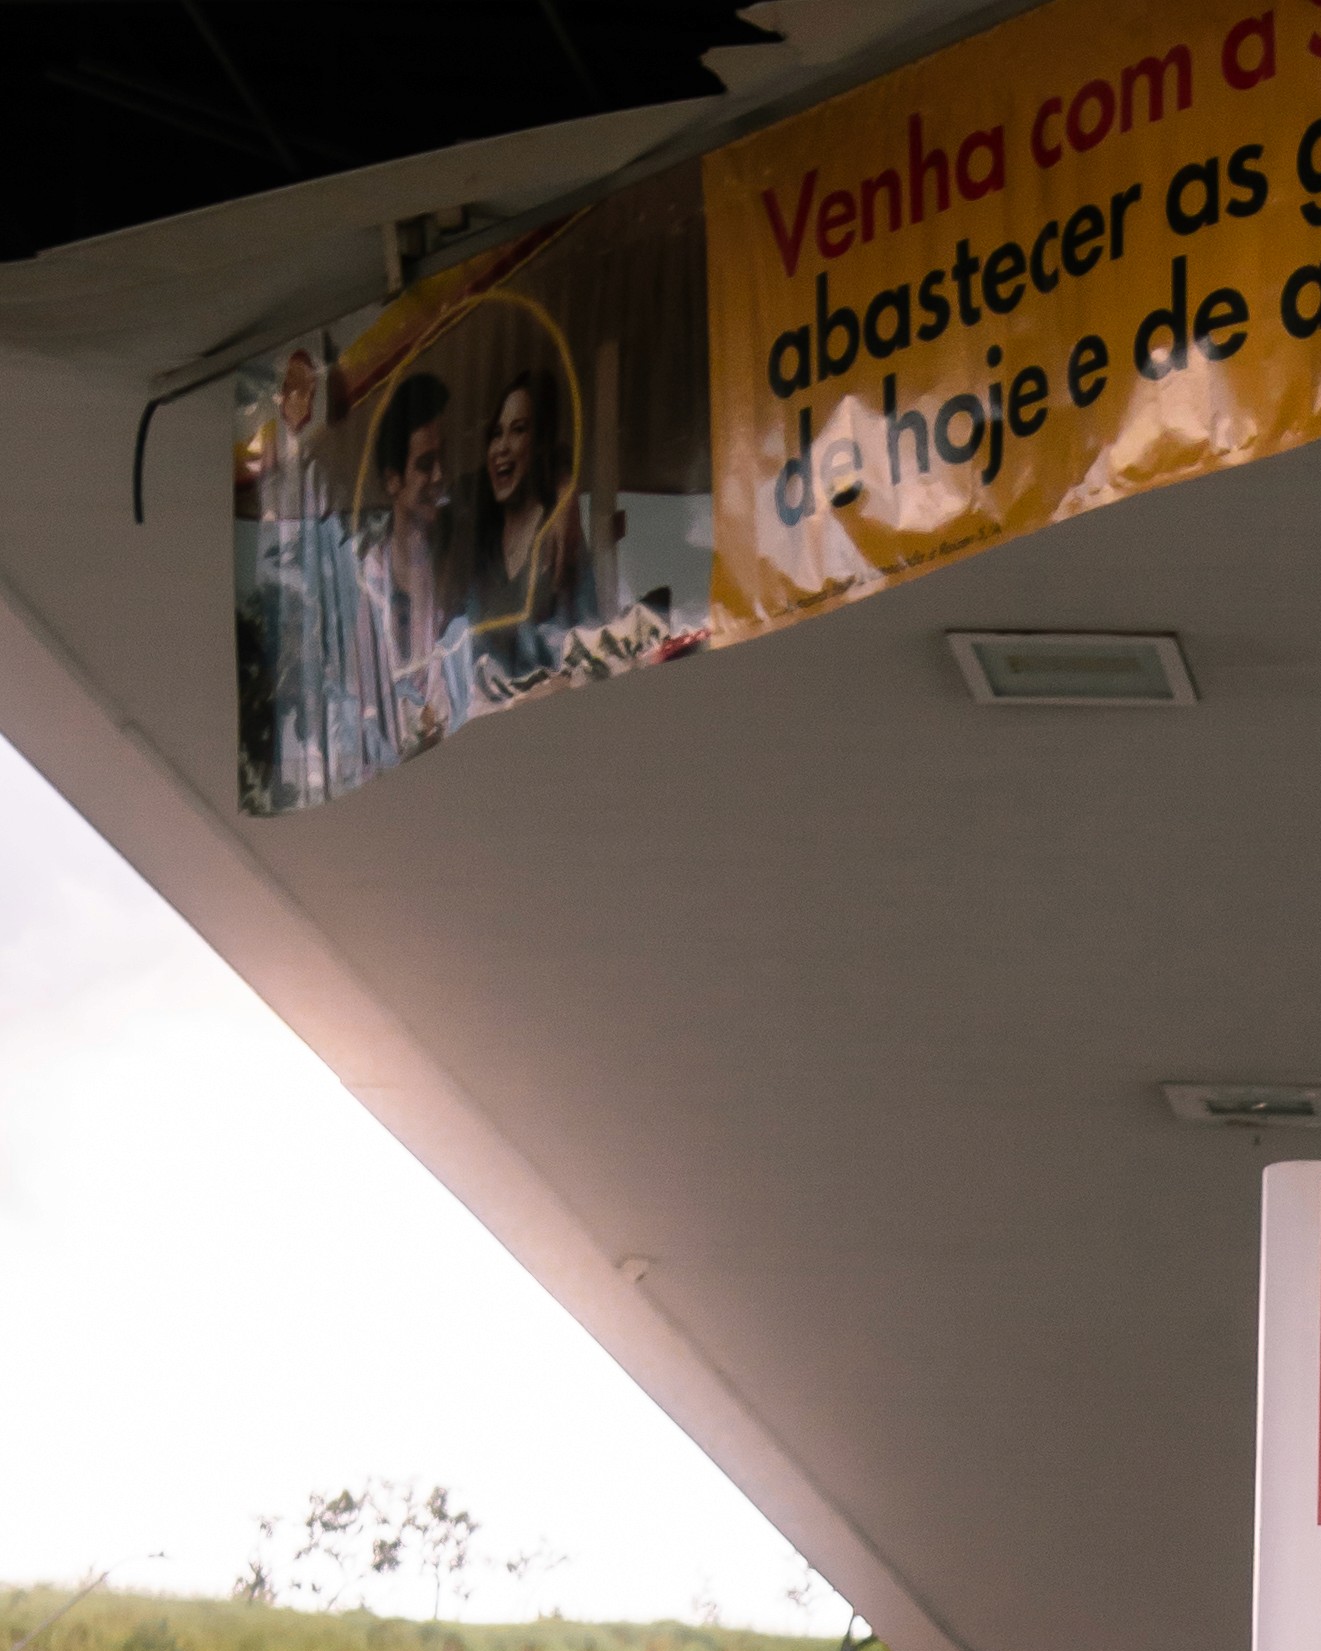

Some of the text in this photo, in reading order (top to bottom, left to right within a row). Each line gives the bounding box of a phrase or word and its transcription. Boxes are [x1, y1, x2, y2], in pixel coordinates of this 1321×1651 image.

[762, 112, 1006, 278] Venha
[1030, 44, 1193, 169] com
[1221, 7, 1276, 90] a
[768, 183, 1141, 399] abastecer
[1166, 143, 1269, 236] as
[774, 408, 863, 528] de
[882, 346, 1048, 486] hoje
[1068, 335, 1109, 408] e
[1134, 256, 1249, 380] de
